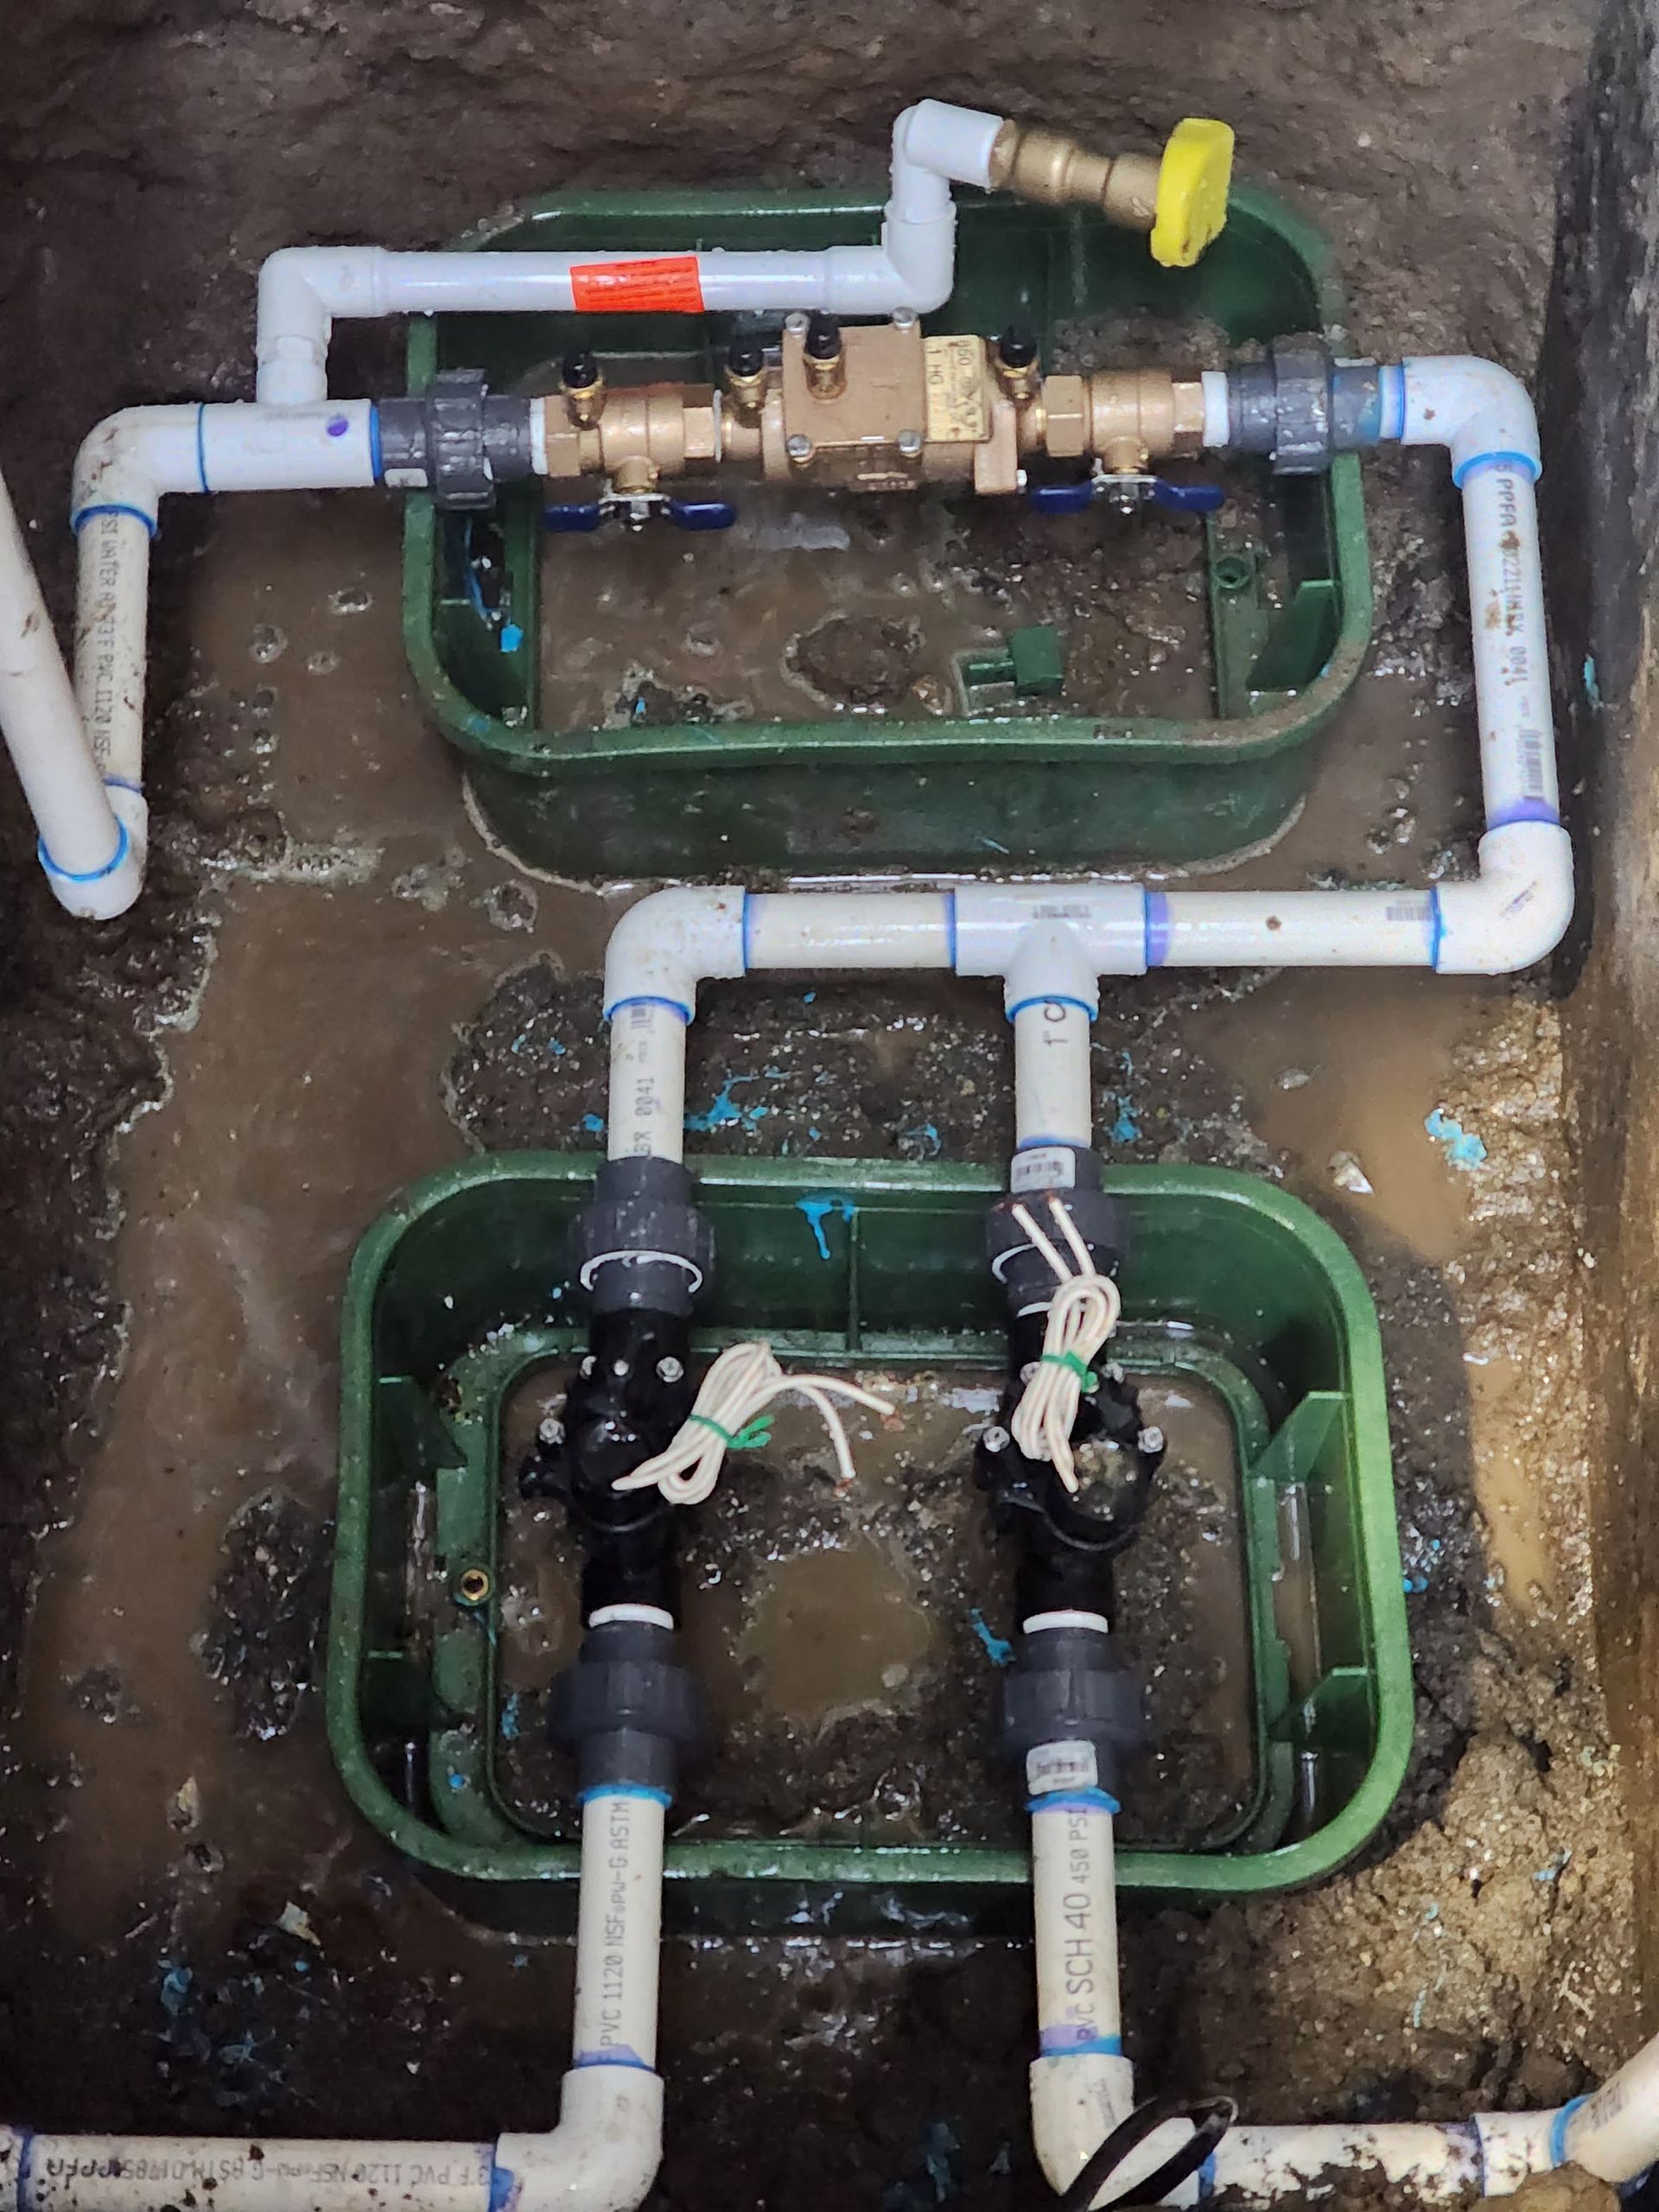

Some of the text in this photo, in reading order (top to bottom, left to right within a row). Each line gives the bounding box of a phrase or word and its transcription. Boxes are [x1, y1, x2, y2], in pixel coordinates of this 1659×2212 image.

[1496, 478, 1517, 526] PPFA
[634, 1077, 654, 1117] 0041
[609, 1801, 629, 1850] ASTM
[1063, 1808, 1096, 2041] PVC SCH 40 450 PSI
[602, 1955, 624, 2001] 1120
[600, 2008, 621, 2047] PVC
[410, 2164, 450, 2186] PVC
